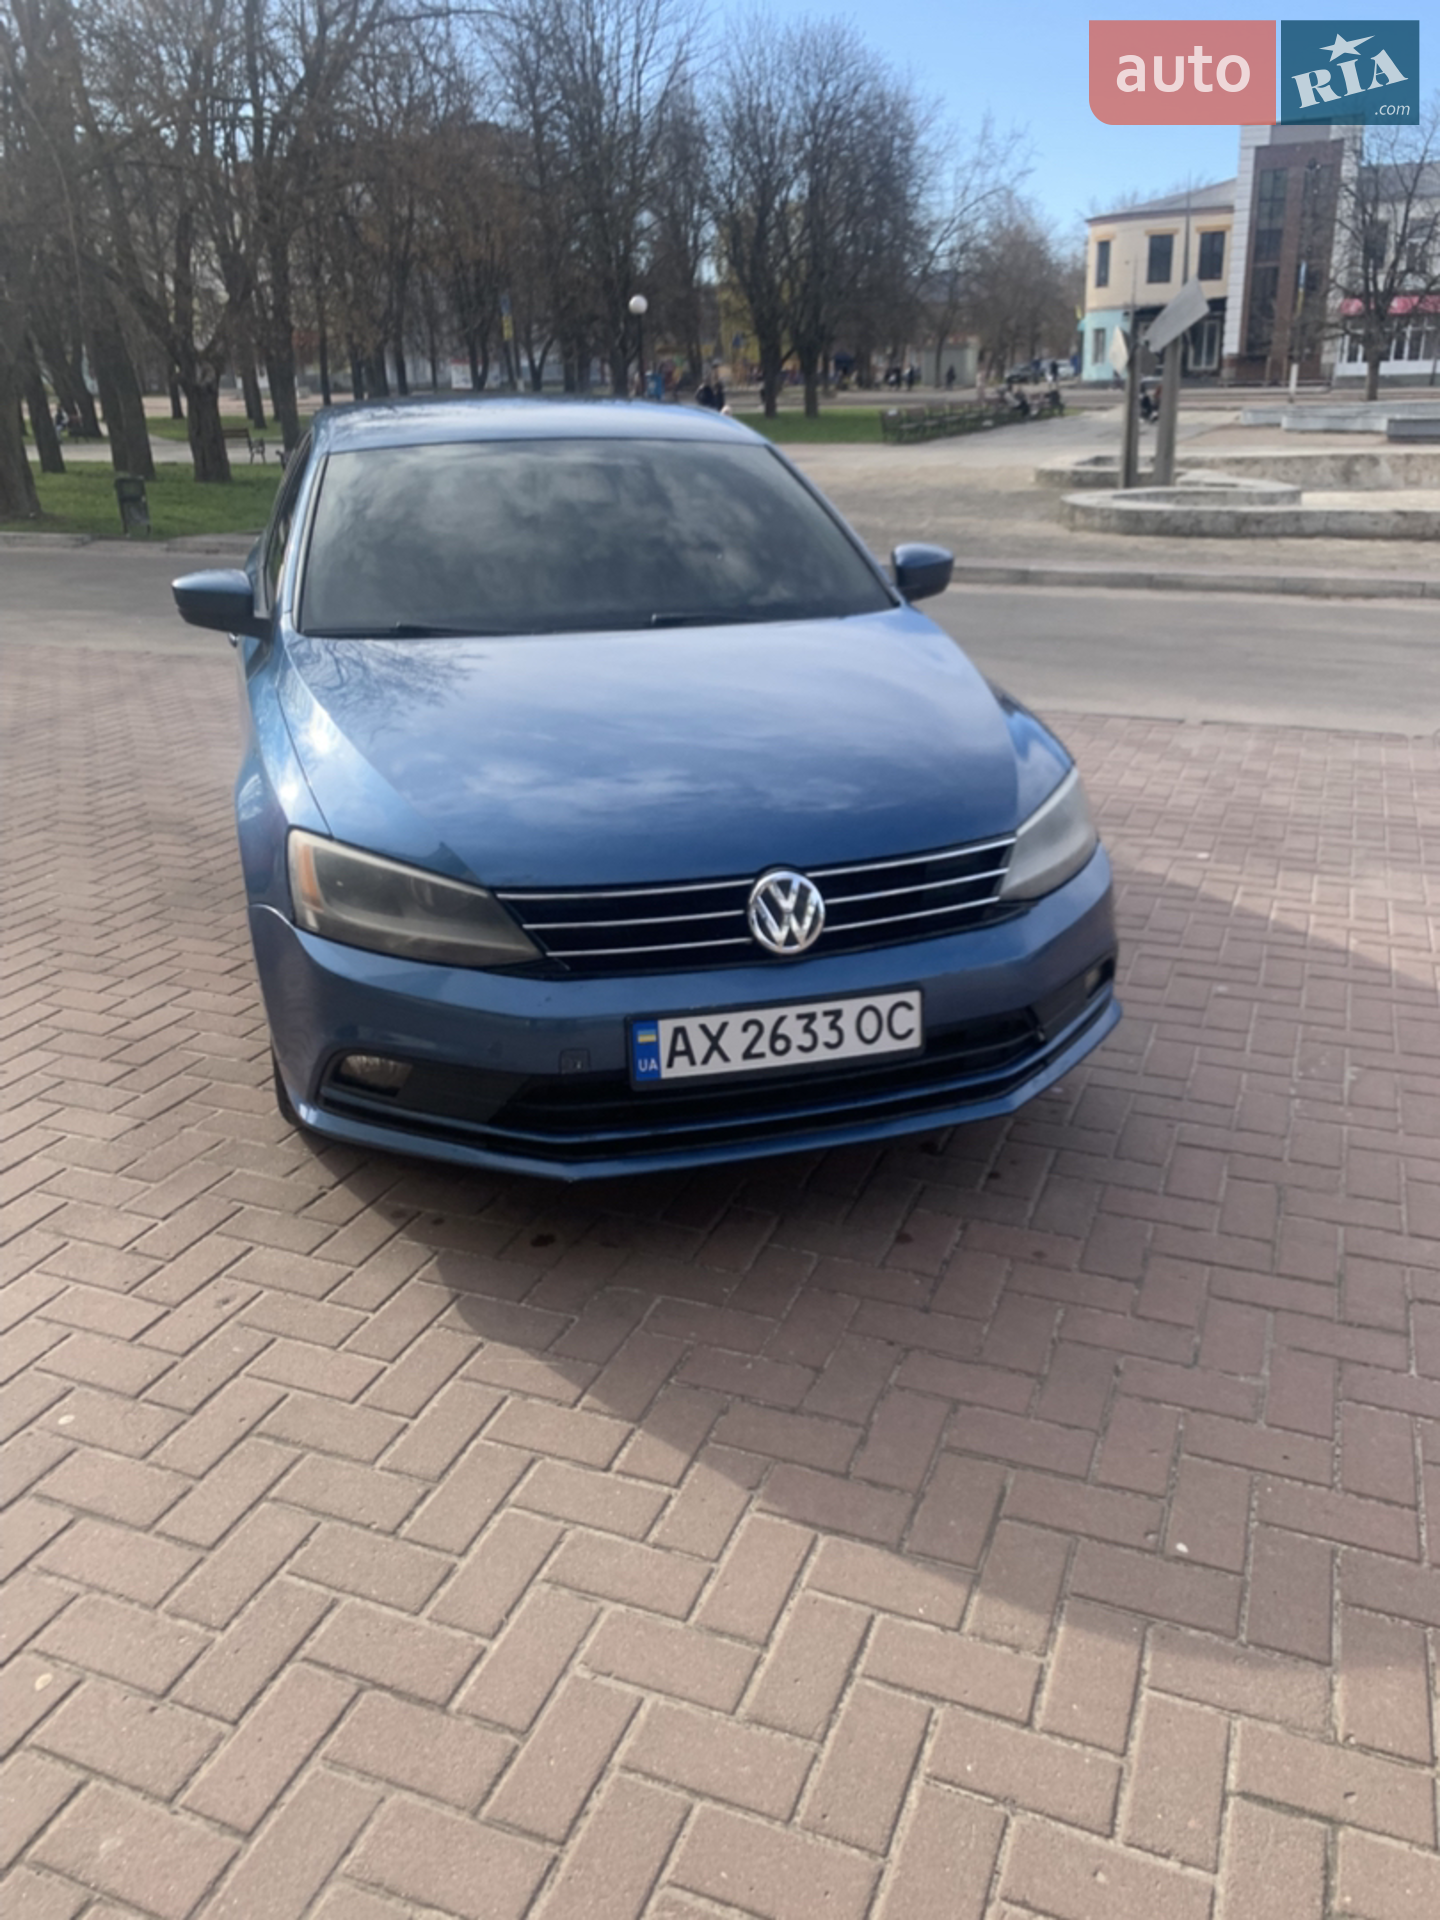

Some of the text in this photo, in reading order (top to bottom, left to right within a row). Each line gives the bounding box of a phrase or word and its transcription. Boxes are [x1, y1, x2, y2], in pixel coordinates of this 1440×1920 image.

[666, 1001, 915, 1069] AX 2633 OC
[638, 1058, 659, 1072] UA
